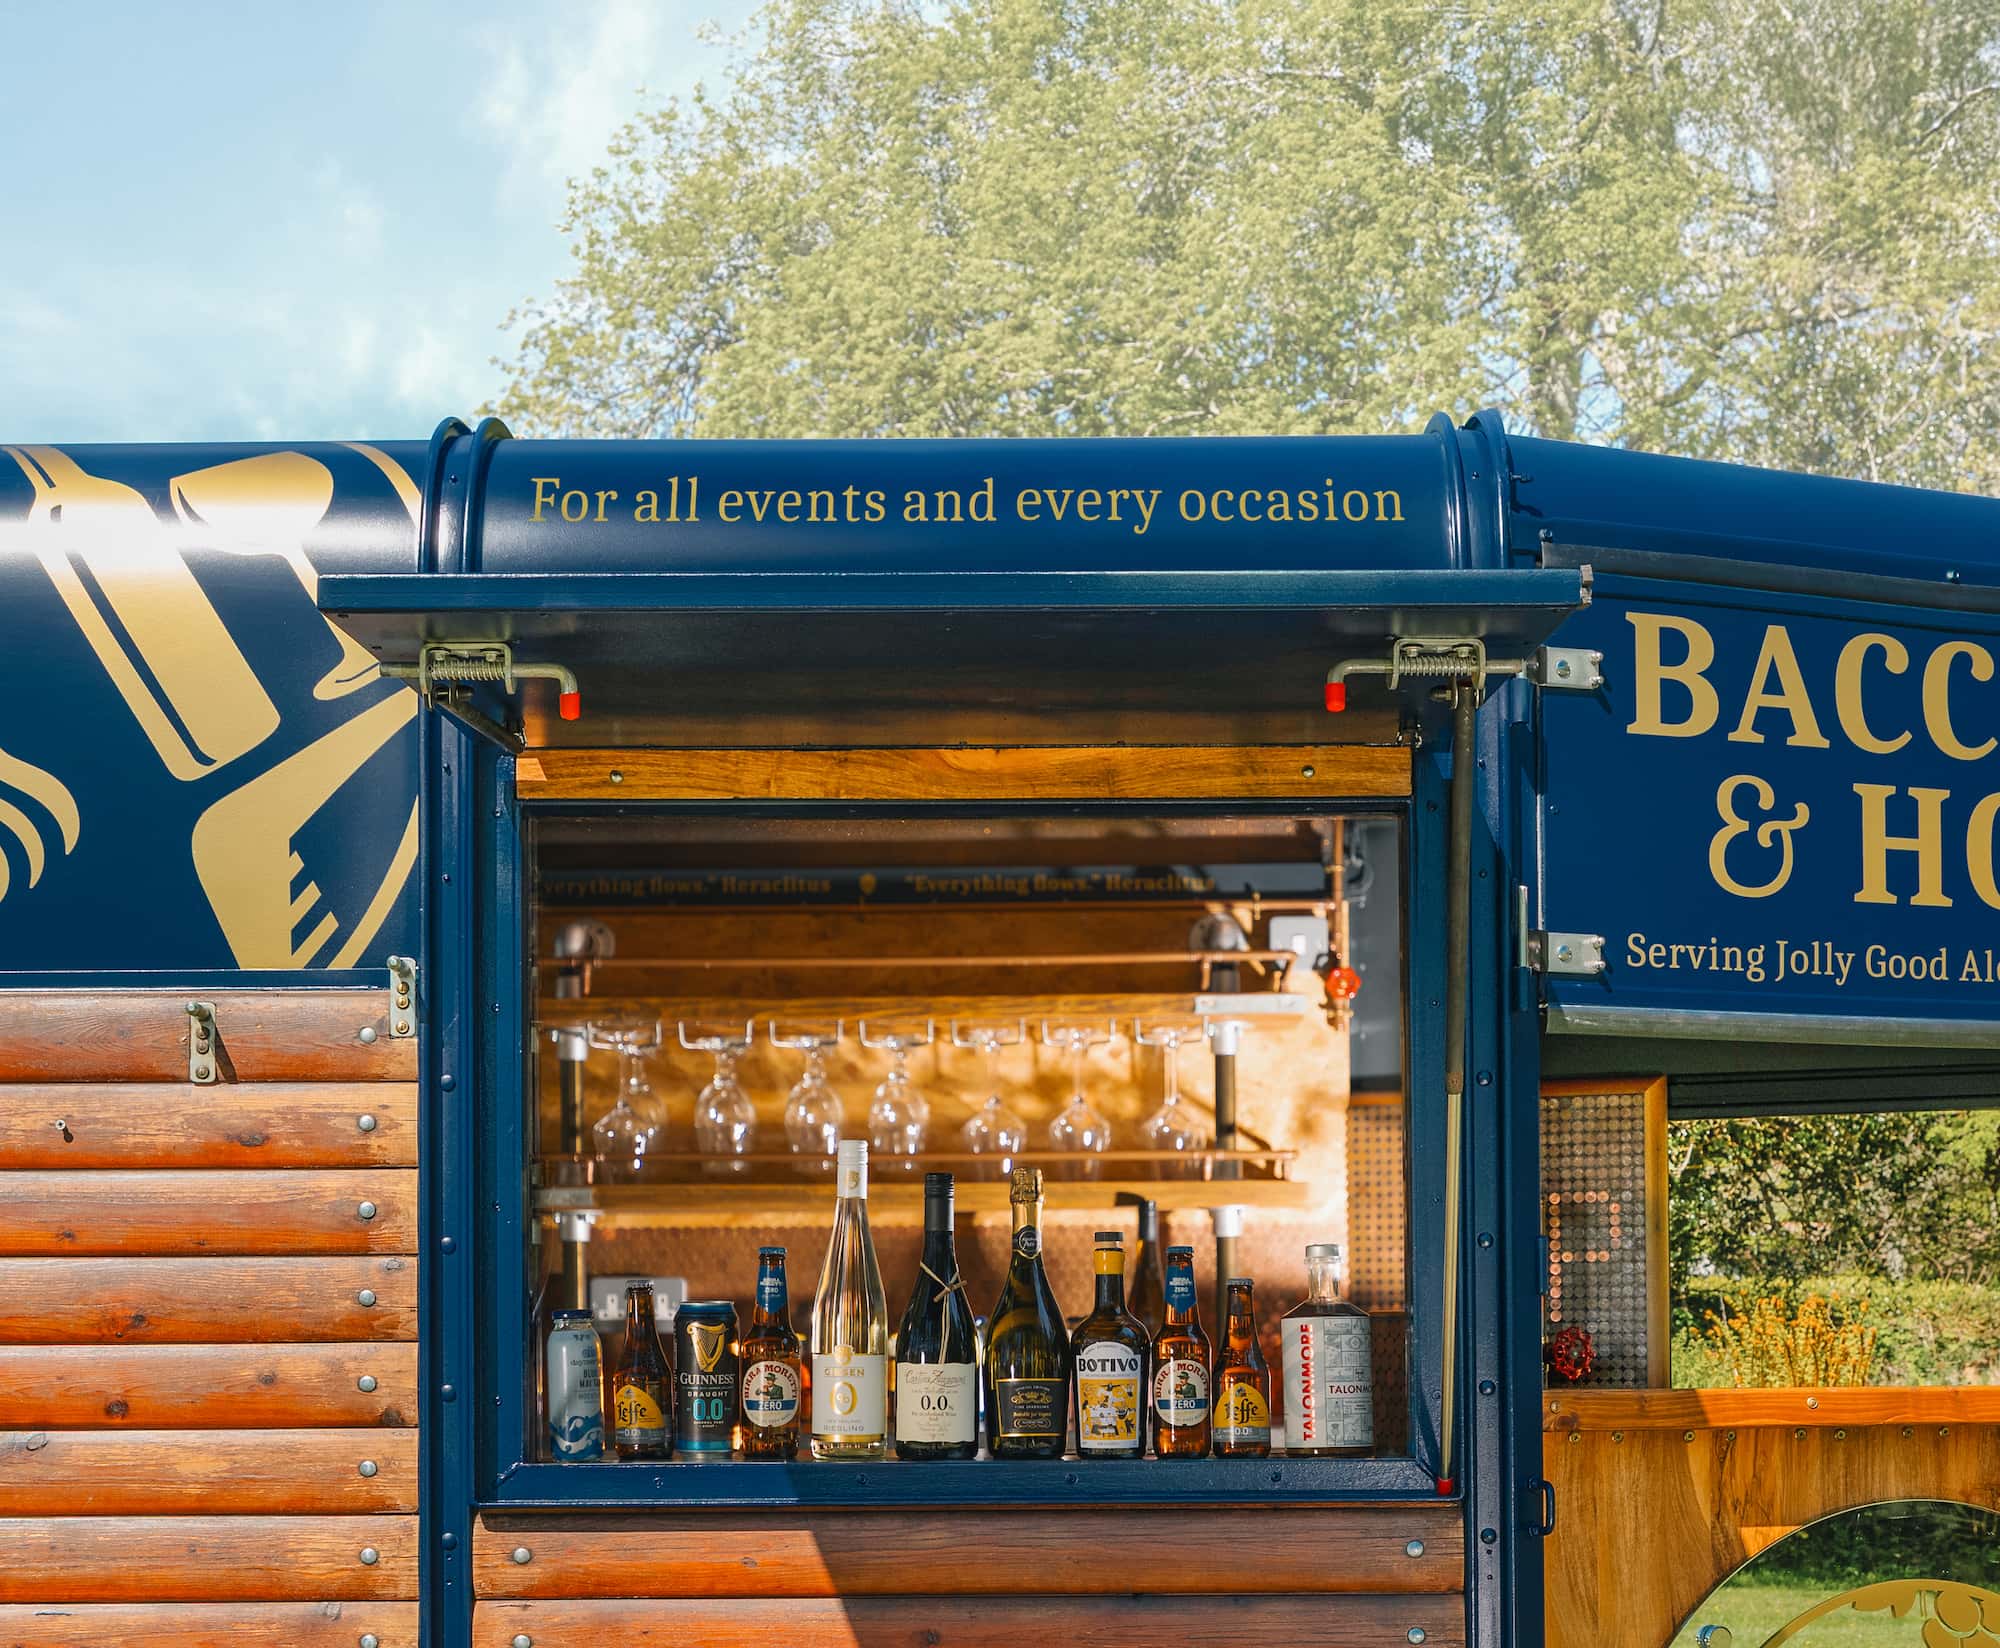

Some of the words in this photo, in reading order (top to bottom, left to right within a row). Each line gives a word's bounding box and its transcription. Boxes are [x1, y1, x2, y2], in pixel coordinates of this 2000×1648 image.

[529, 477, 618, 523] For
[633, 476, 698, 523] all
[718, 486, 886, 523] events
[903, 477, 996, 522] and
[1016, 489, 1161, 535] every
[1179, 479, 1404, 522] occasion
[1625, 611, 1998, 761] BACC
[1709, 774, 1810, 898] &
[1626, 932, 1766, 983] Serving
[1775, 940, 1856, 986] Jolly
[1865, 945, 1949, 981] Good
[1959, 949, 2000, 983] Al
[680, 1372, 736, 1385] GUINNESS
[1078, 1358, 1138, 1372] BOTIVO
[693, 1398, 723, 1420] 0.0
[758, 1401, 782, 1410] ZERO
